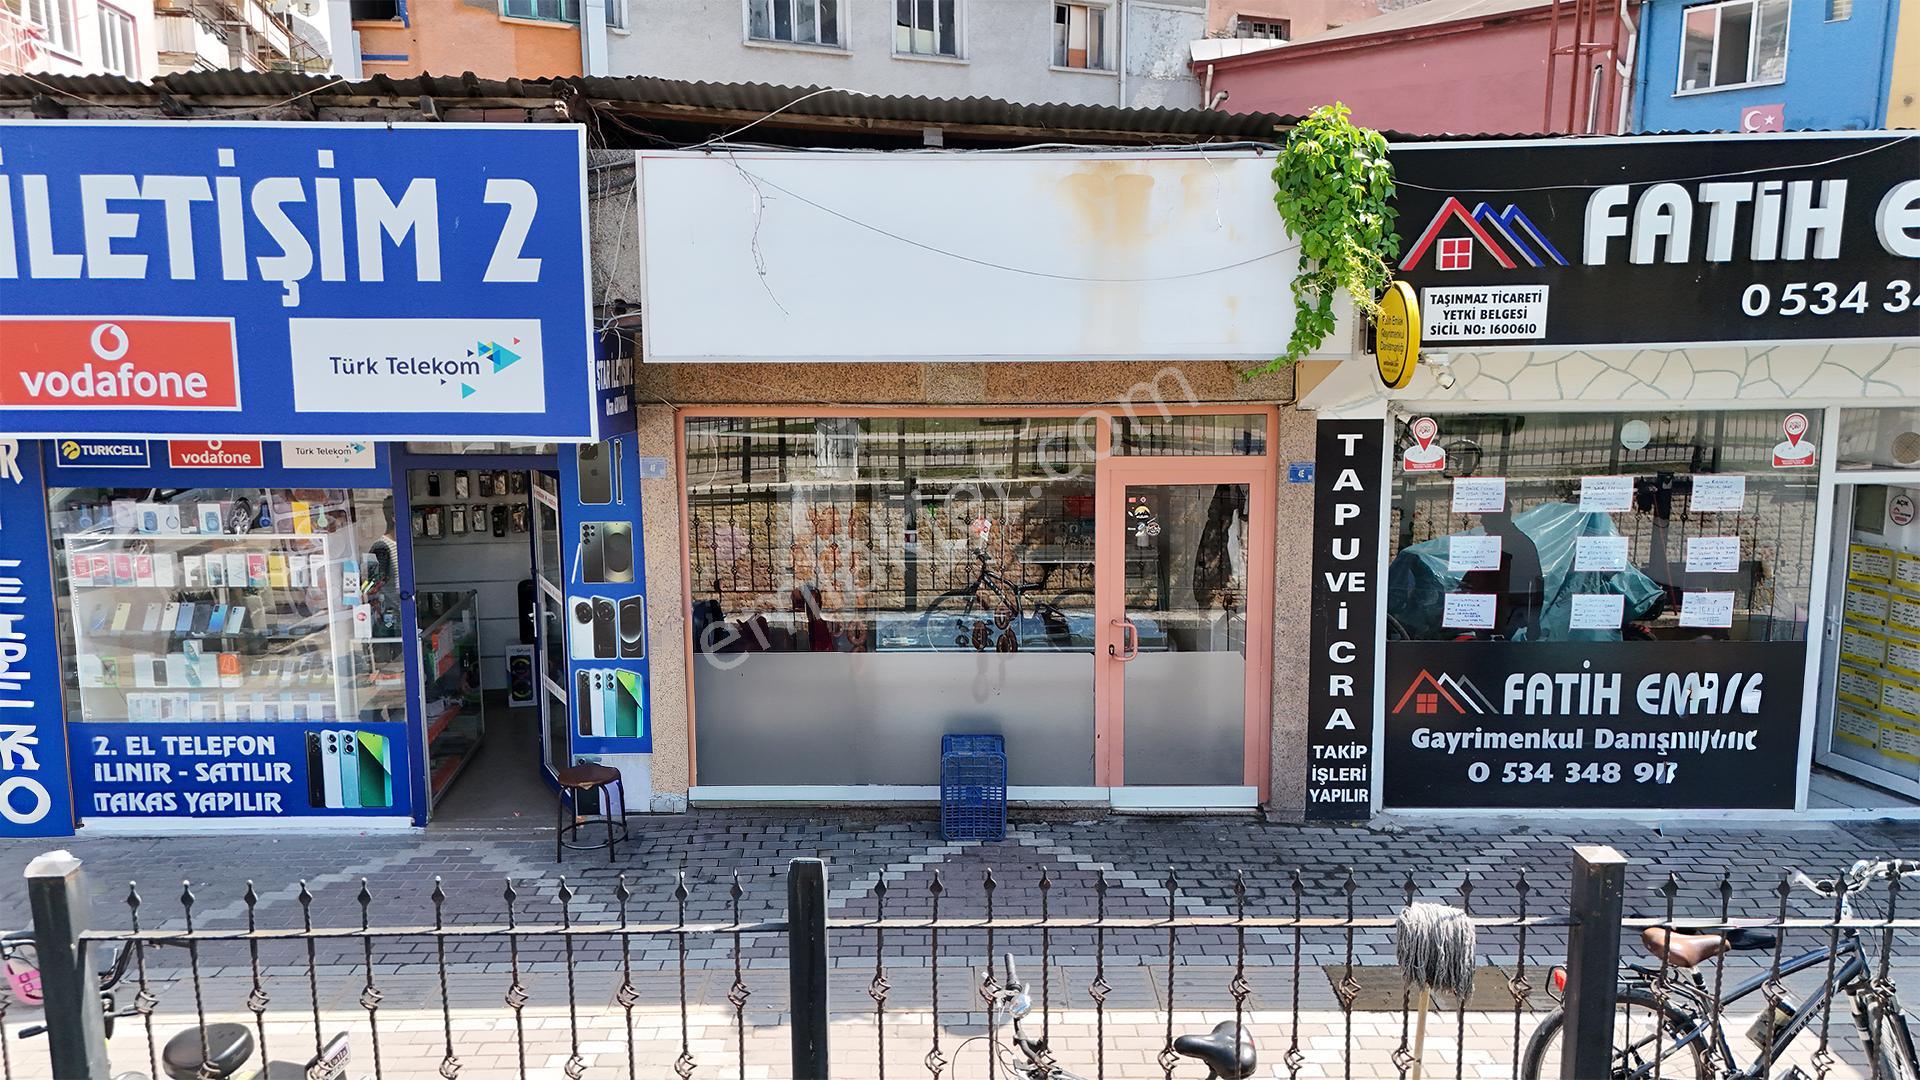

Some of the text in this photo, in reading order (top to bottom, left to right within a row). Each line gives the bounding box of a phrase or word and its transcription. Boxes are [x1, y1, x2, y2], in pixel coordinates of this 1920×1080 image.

[0, 147, 543, 307] İLETİŞİM 2
[1583, 179, 1848, 266] FATİH
[1430, 289, 1542, 307] TAŞINMAZ TİCARETİ
[1882, 279, 1920, 313] 3
[1443, 306, 1528, 321] YETKİ BELGESİ
[1430, 322, 1537, 335] SİCİL NO: 1600610
[329, 356, 480, 376] Türk Telekom
[20, 363, 208, 399] vodafone
[81, 444, 143, 457] TURKCELL
[181, 451, 251, 465] vodafone
[295, 447, 351, 456] Türk Telekom
[1332, 434, 1364, 560] TAPU
[1325, 572, 1366, 592] VE
[1503, 660, 1622, 715] FATİH
[93, 736, 275, 757] 2. EL TELEFON
[1313, 741, 1368, 759] TAKİP
[1411, 727, 1584, 754] Gayrimenkul
[195, 762, 293, 784] SATILIR
[1312, 764, 1367, 785] İŞLERİ
[1468, 762, 1490, 783] 0
[1501, 762, 1553, 783] 534
[1565, 762, 1621, 783] 348
[94, 792, 282, 813] TAKAS YAPILIR
[1309, 788, 1369, 803] YAPILIR
